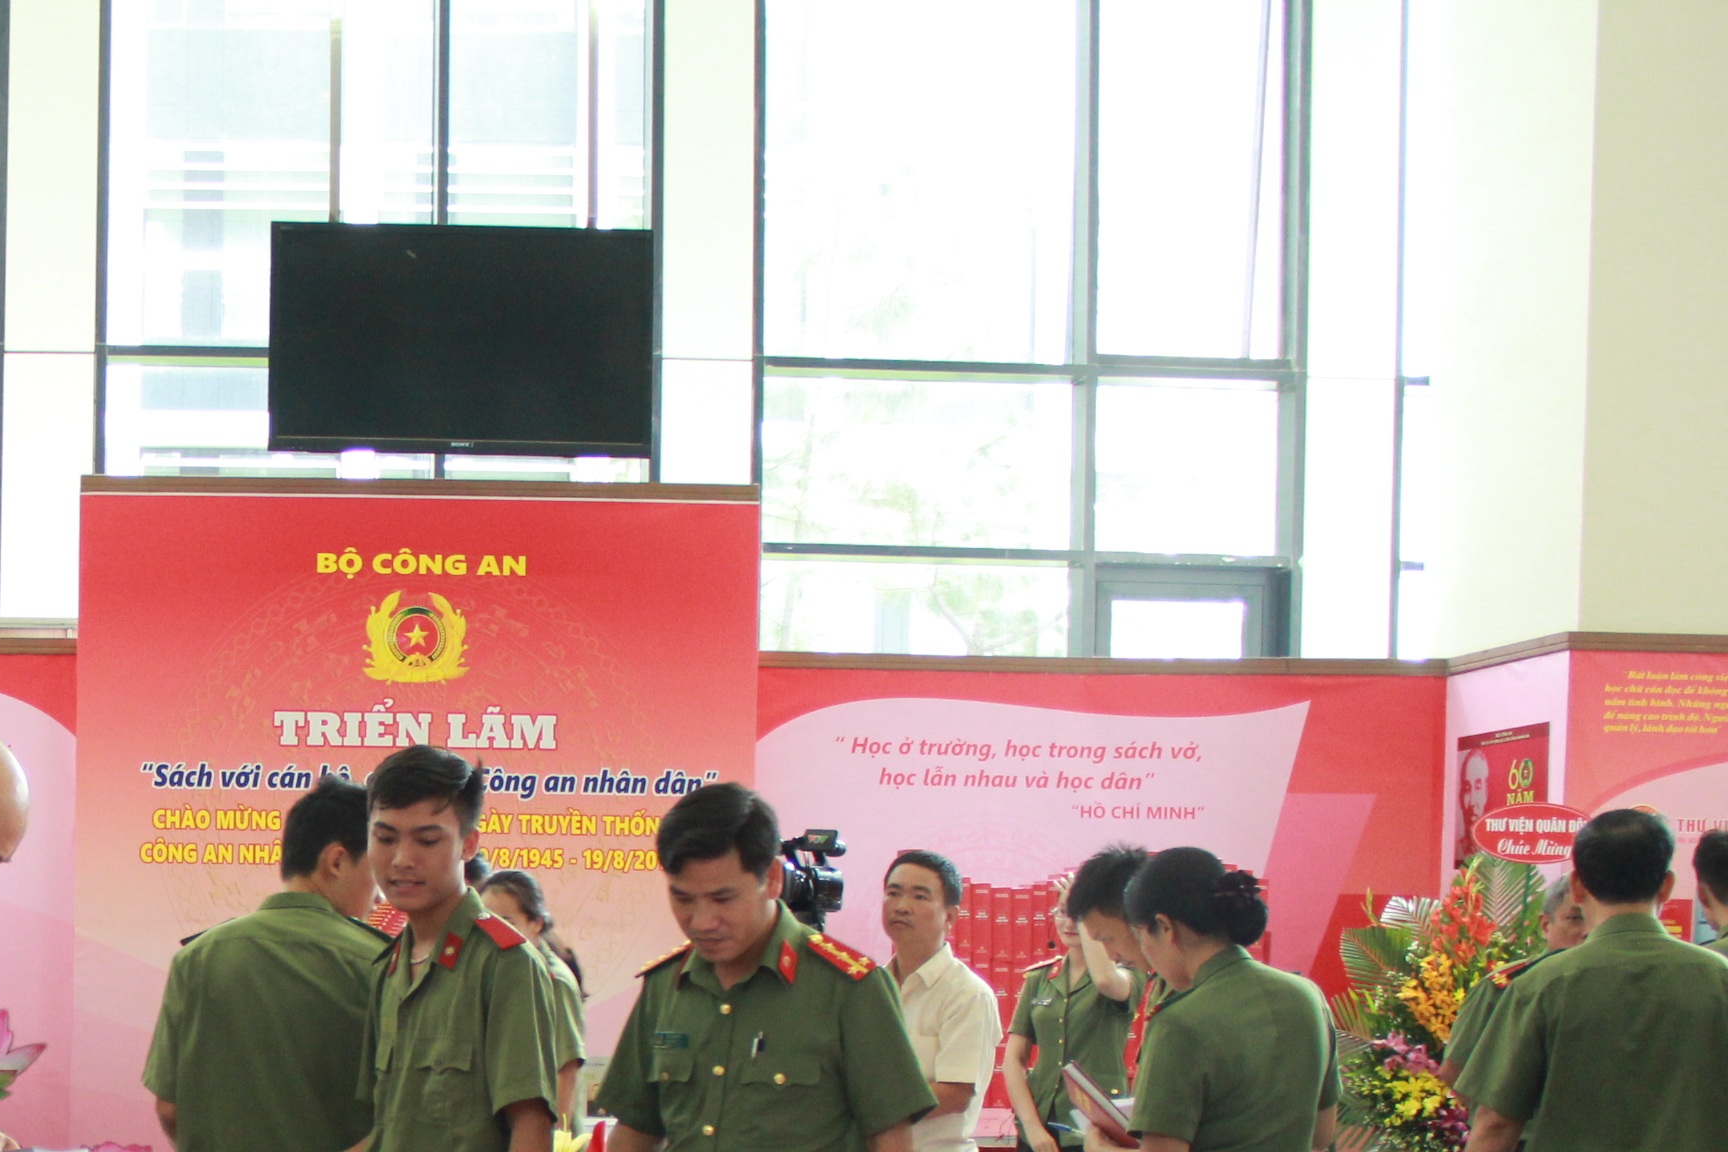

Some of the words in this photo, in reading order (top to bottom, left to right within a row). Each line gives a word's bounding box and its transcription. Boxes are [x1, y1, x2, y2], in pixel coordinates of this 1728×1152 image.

[316, 547, 363, 580] BỘ
[372, 548, 468, 576] CÔNG
[476, 555, 527, 577] AN
[274, 698, 432, 748] TRIỂN
[447, 706, 557, 750] LÃM
[851, 736, 892, 758] Học
[898, 736, 914, 755] ở
[919, 738, 997, 762] trường,
[1004, 739, 1042, 762] học
[1049, 742, 1107, 764] trong
[1113, 741, 1163, 760] sách
[1171, 741, 1202, 762] vở,
[141, 762, 212, 788] "Sách
[220, 765, 262, 788] với
[267, 767, 312, 789] cán
[544, 774, 576, 793] an
[581, 769, 648, 795] nhân
[879, 767, 917, 790] học
[923, 766, 958, 788] lẫn
[963, 769, 1019, 788] nhau
[1025, 771, 1050, 789] và
[1056, 771, 1095, 793] học
[1100, 772, 1155, 791] dân"
[152, 804, 212, 830] CHÀO
[216, 805, 282, 831] MỪNG
[477, 808, 514, 835] GÀY
[518, 808, 597, 836] TRUYỀN
[602, 808, 661, 836] THỐN
[1111, 803, 1140, 820] CHÍ
[1485, 817, 1508, 832] THƯ
[1509, 816, 1534, 835] VIỆN
[1536, 816, 1566, 835] QUÂN
[140, 838, 199, 864] CÔNG
[203, 843, 234, 864] AN
[238, 842, 283, 864] NHÂ
[582, 850, 664, 873] 19/8/20
